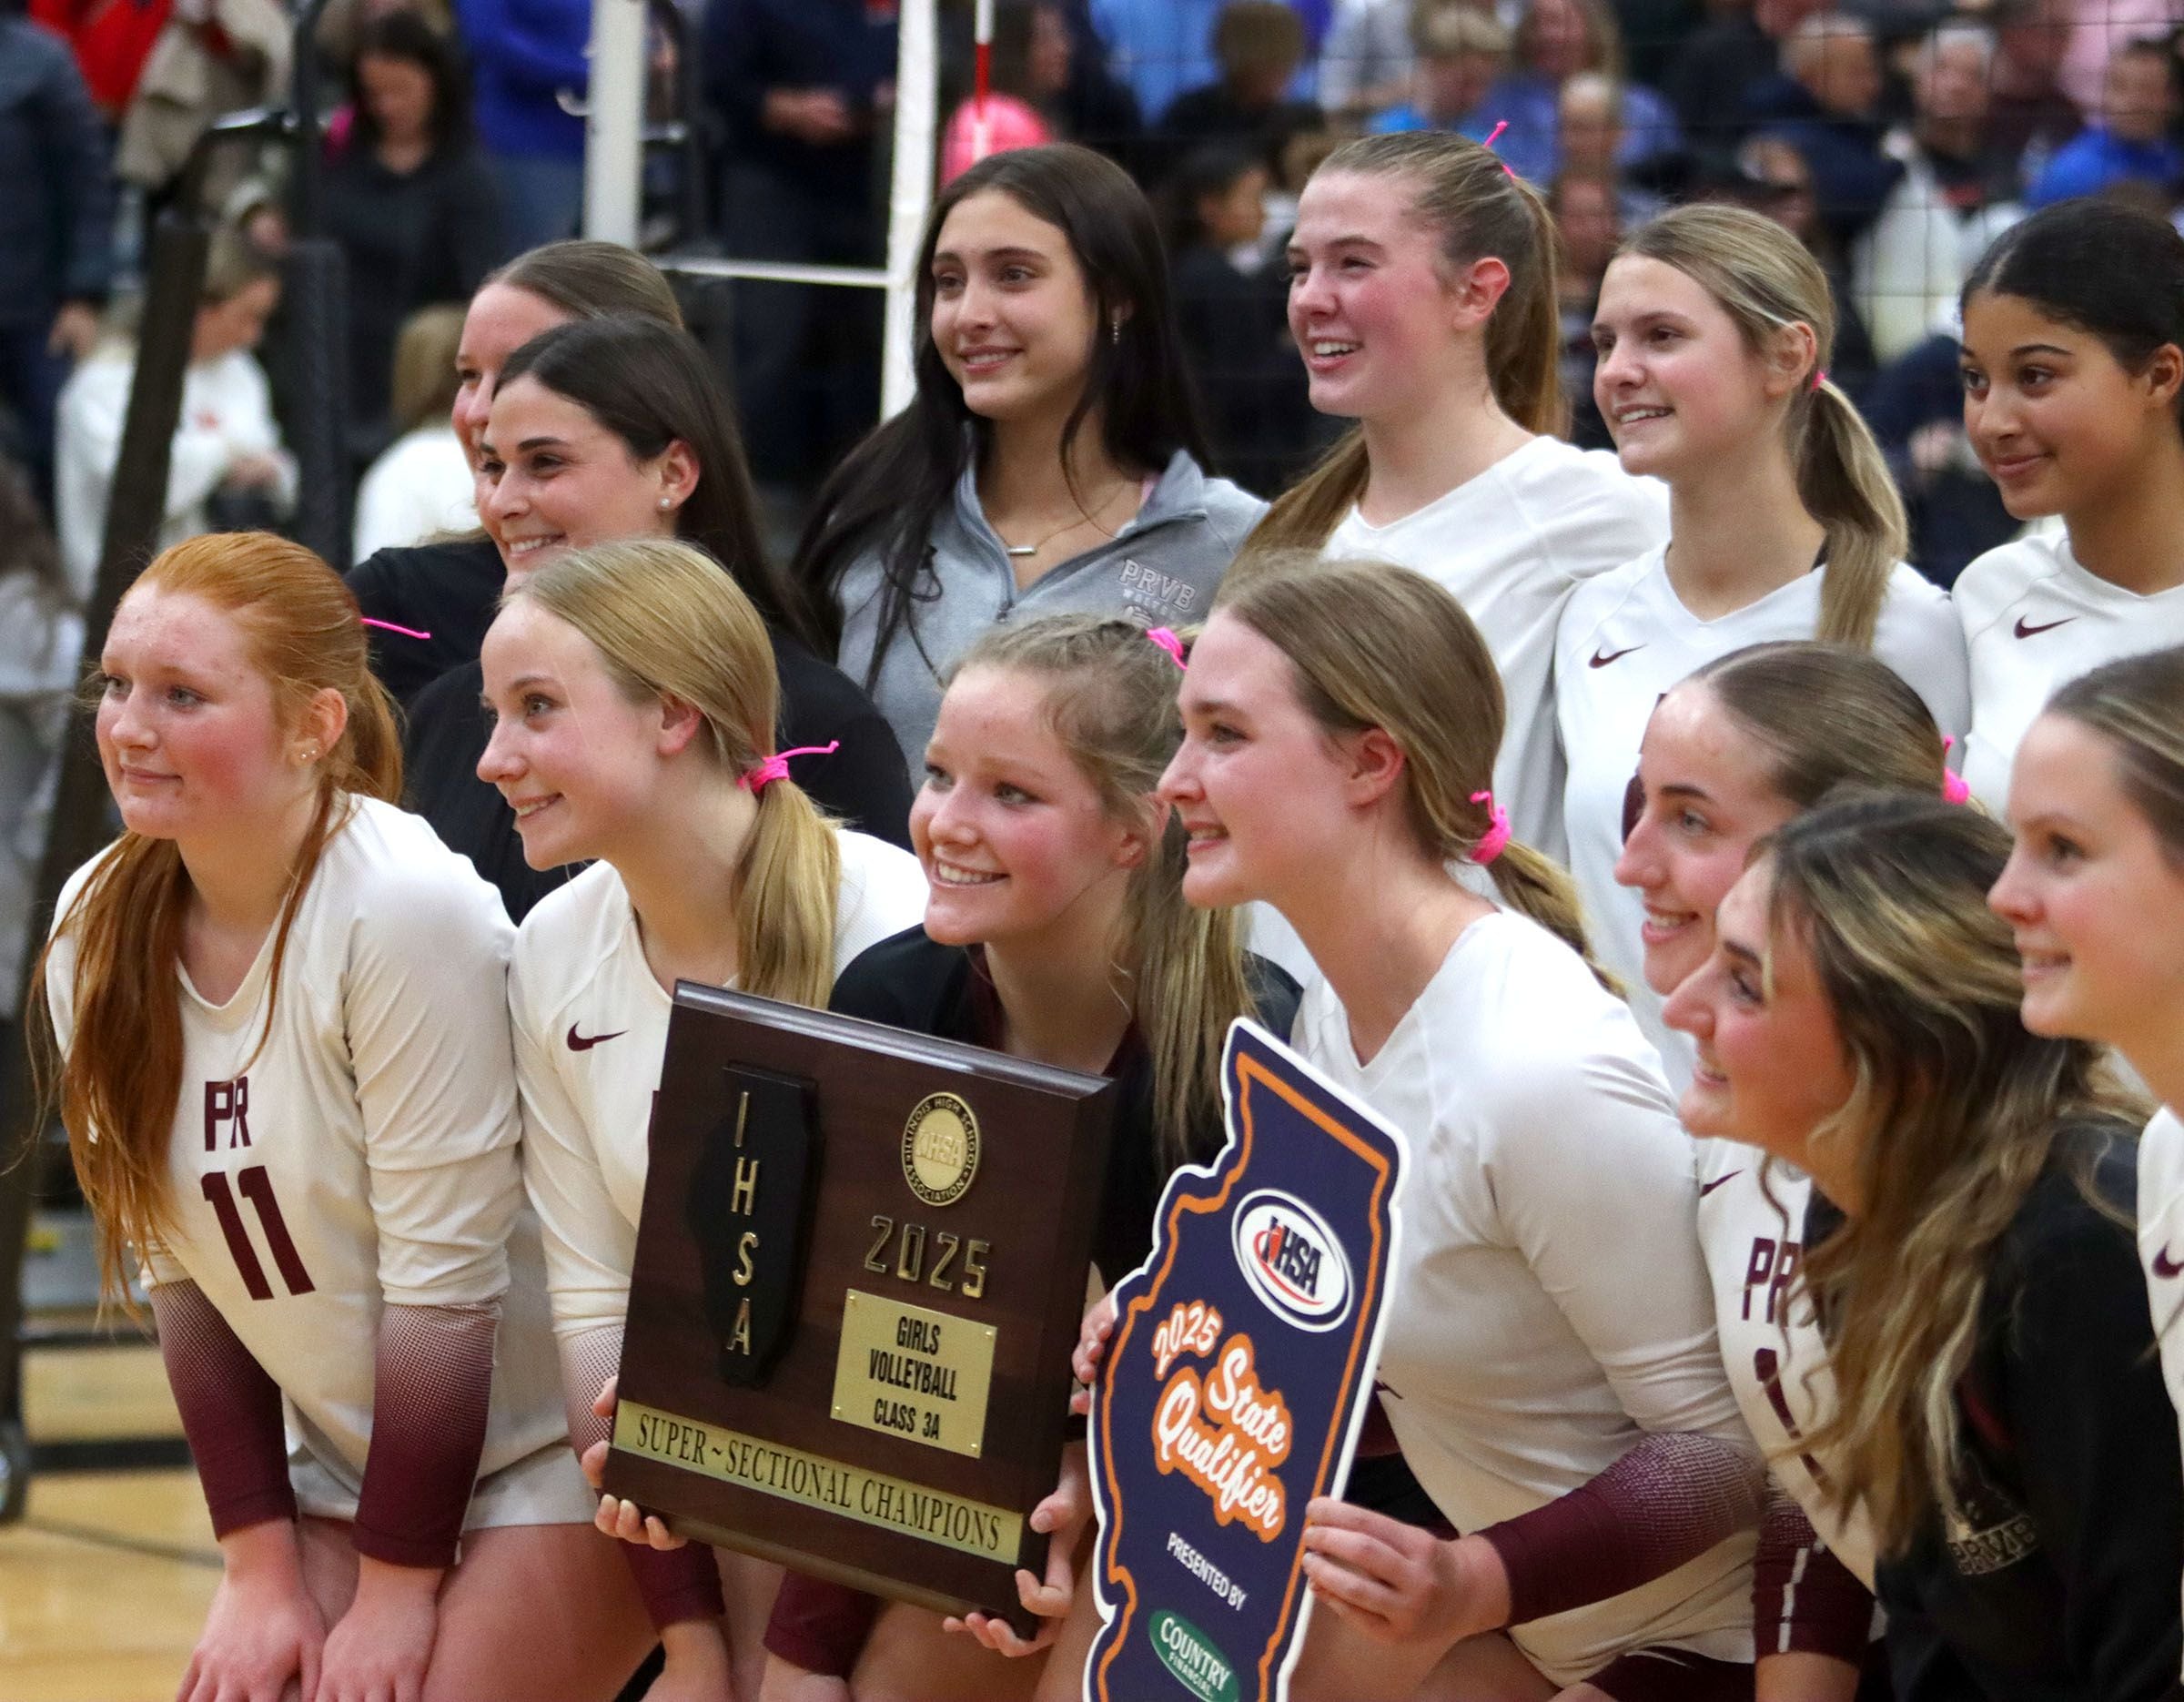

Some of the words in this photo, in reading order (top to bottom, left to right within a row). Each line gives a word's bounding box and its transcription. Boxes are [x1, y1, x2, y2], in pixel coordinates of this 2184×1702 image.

[1119, 559, 1196, 611] PRVB
[204, 1077, 252, 1151] PR
[200, 1165, 316, 1301] 11
[864, 1215, 991, 1298] 2025
[896, 1316, 941, 1355] GIRLS
[1153, 1305, 1221, 1375] 2025
[868, 1348, 956, 1402] VOLLEYBALL
[1208, 1348, 1287, 1454] State
[874, 1399, 915, 1434] CLASS
[923, 1412, 940, 1440] 3A
[1158, 1380, 1279, 1529] Qualifier
[861, 1478, 1002, 1551] CHAMPIONS
[1167, 1532, 1228, 1598] PRESENTED
[1228, 1584, 1249, 1611] BY
[1160, 1616, 1231, 1692] COUNTRY
